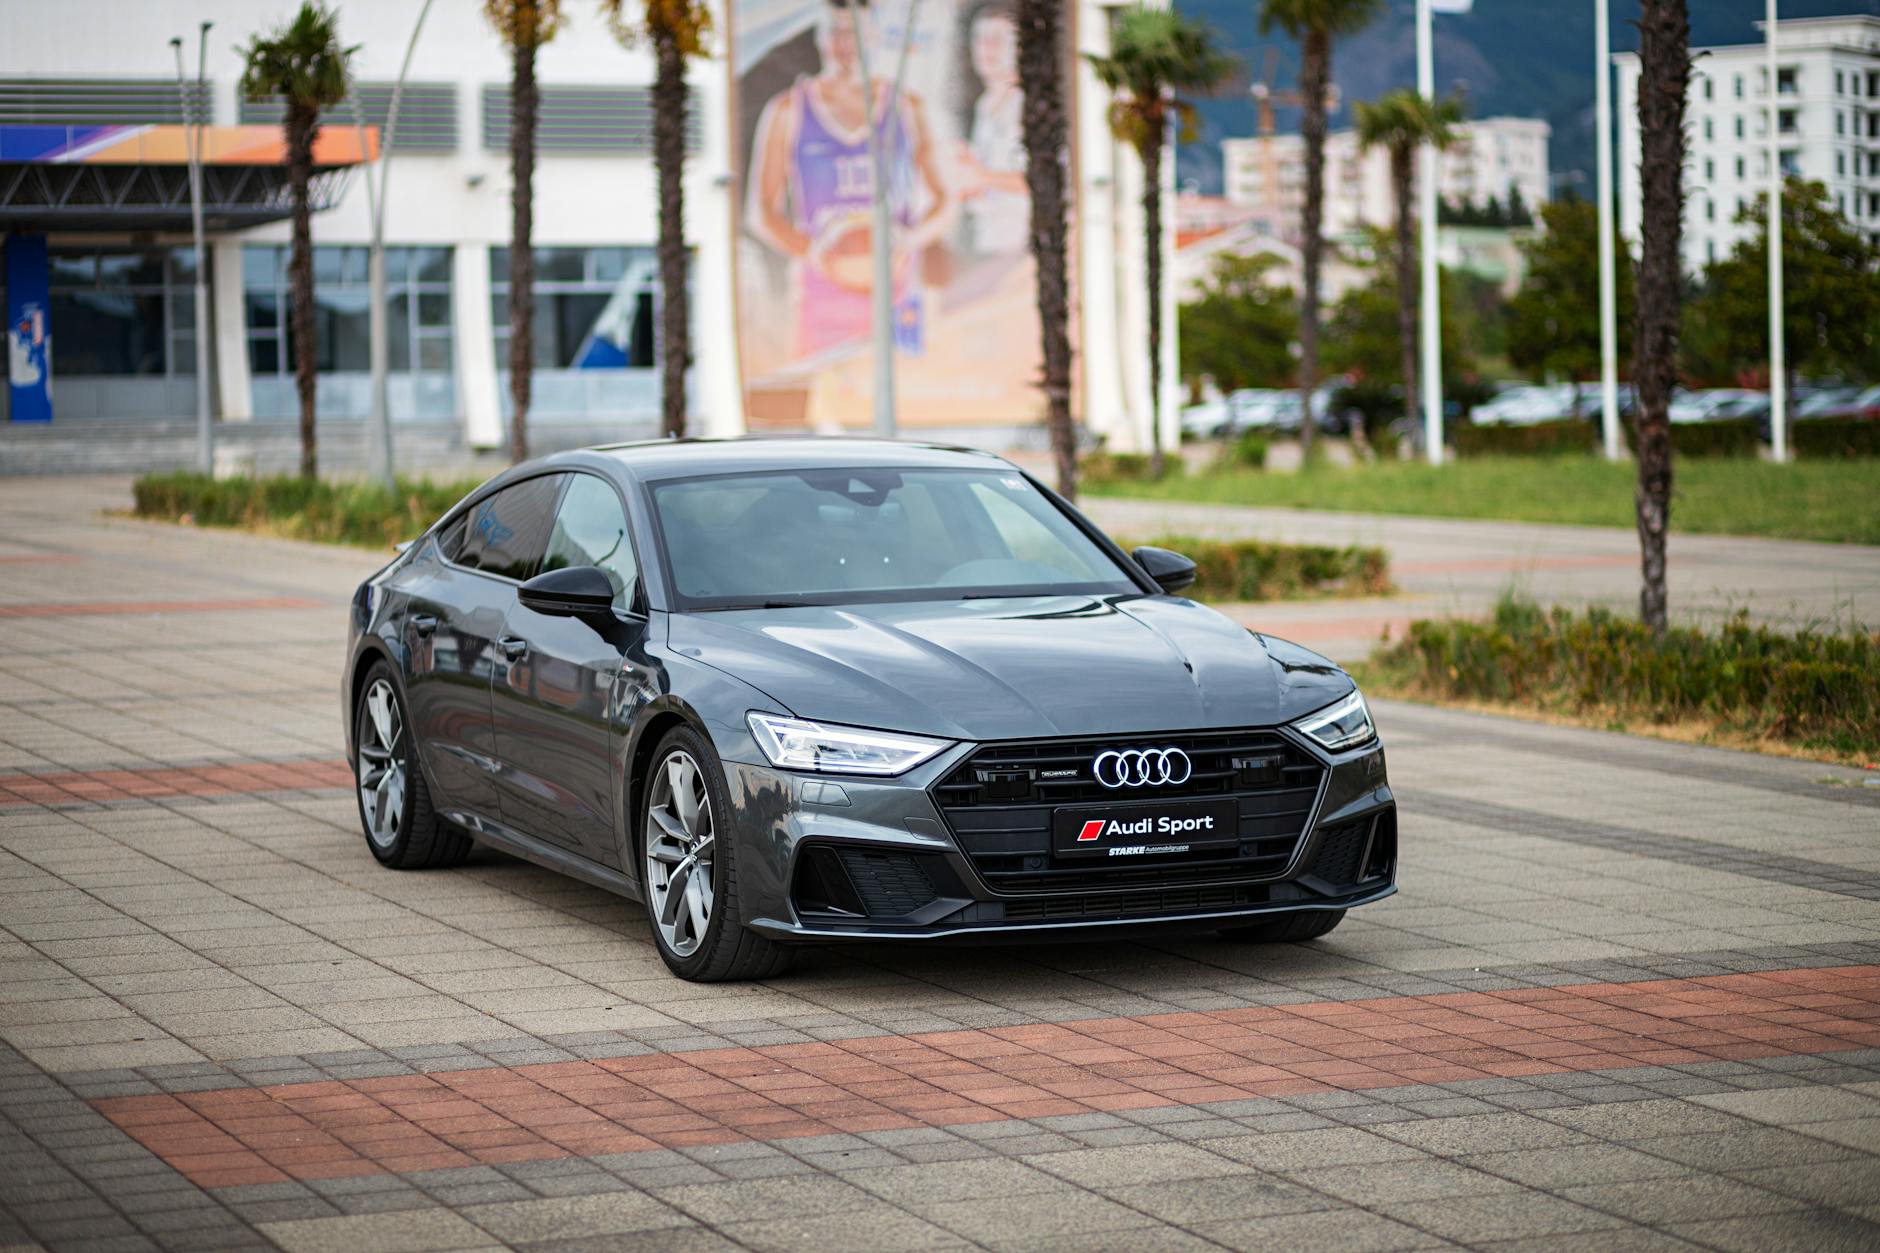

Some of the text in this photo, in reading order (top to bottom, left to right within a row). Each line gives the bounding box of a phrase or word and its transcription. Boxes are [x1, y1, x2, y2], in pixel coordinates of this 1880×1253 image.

[1106, 815, 1213, 836] Audi Sport
[1108, 846, 1146, 857] STARKE
